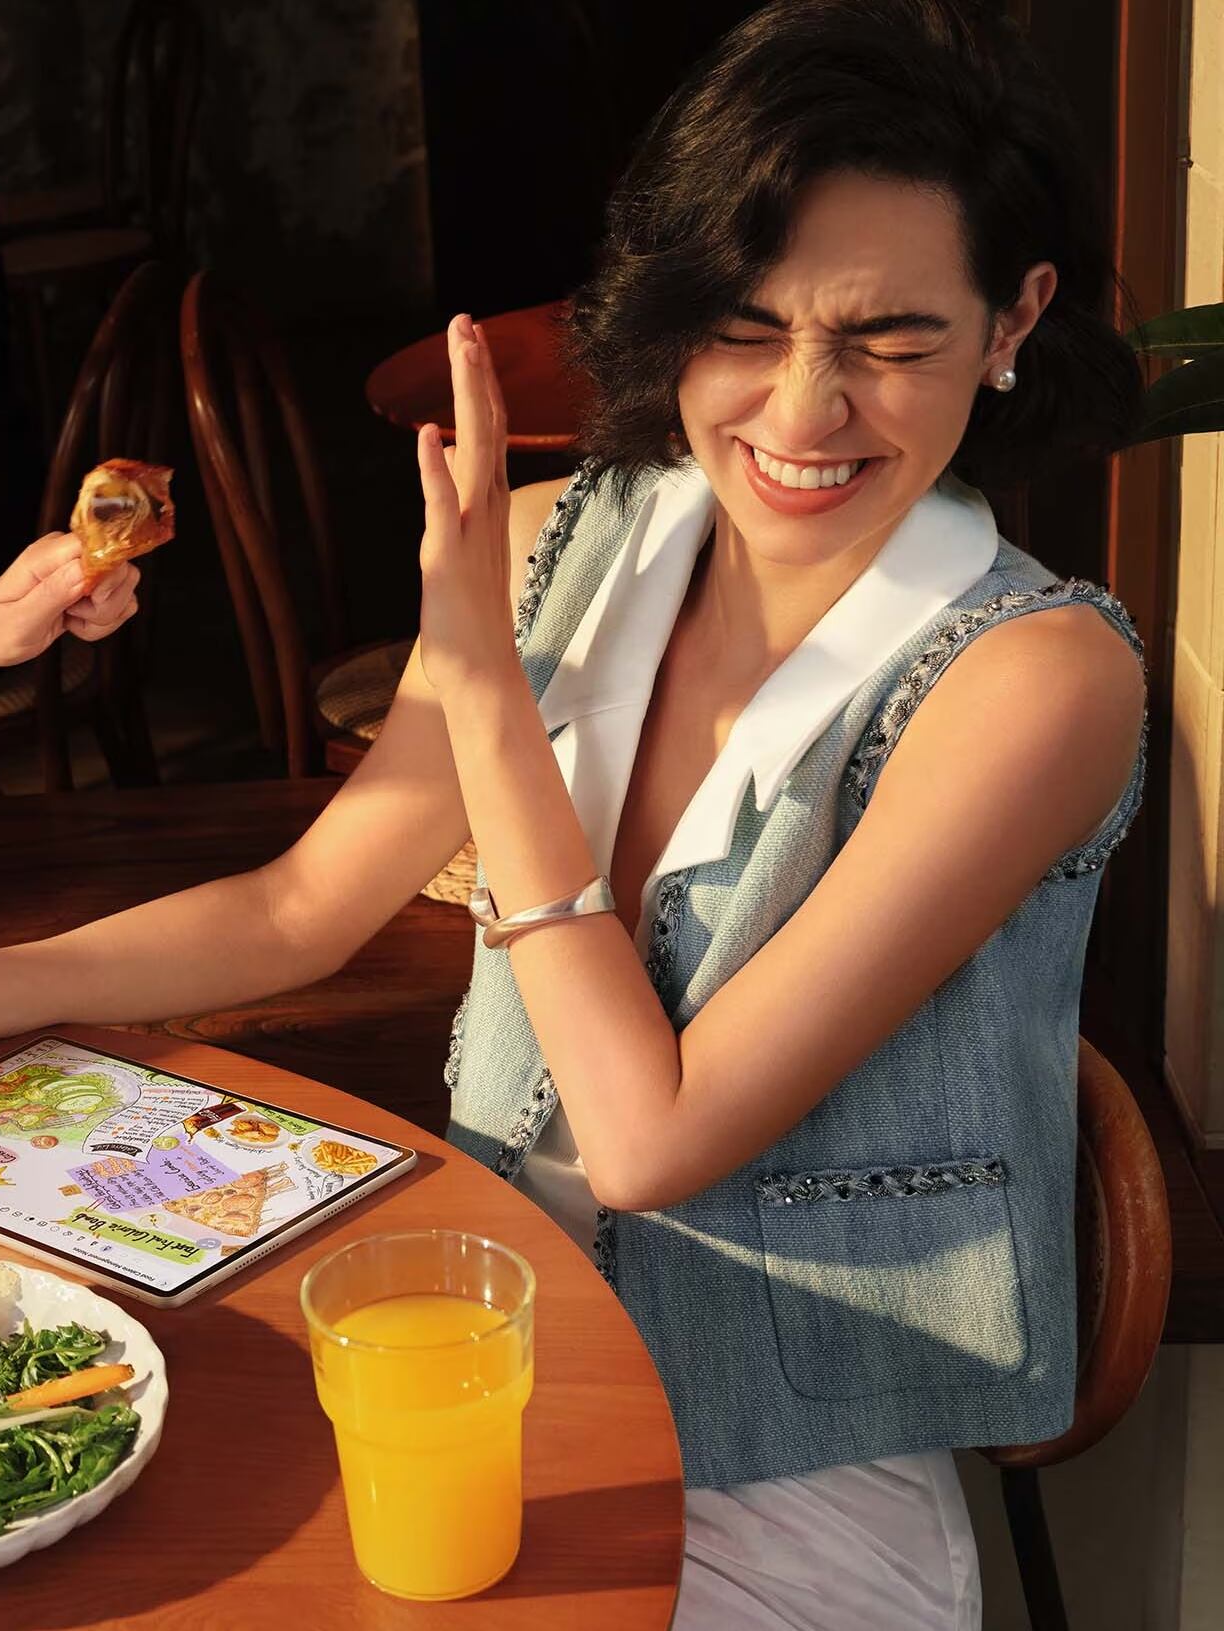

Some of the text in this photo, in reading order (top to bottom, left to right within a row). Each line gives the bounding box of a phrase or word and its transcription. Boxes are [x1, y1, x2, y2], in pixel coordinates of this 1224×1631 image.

[71, 1213, 200, 1258] Fast Food Calorie Bomb
[72, 1247, 155, 1282] Food Calorie Management Notes
